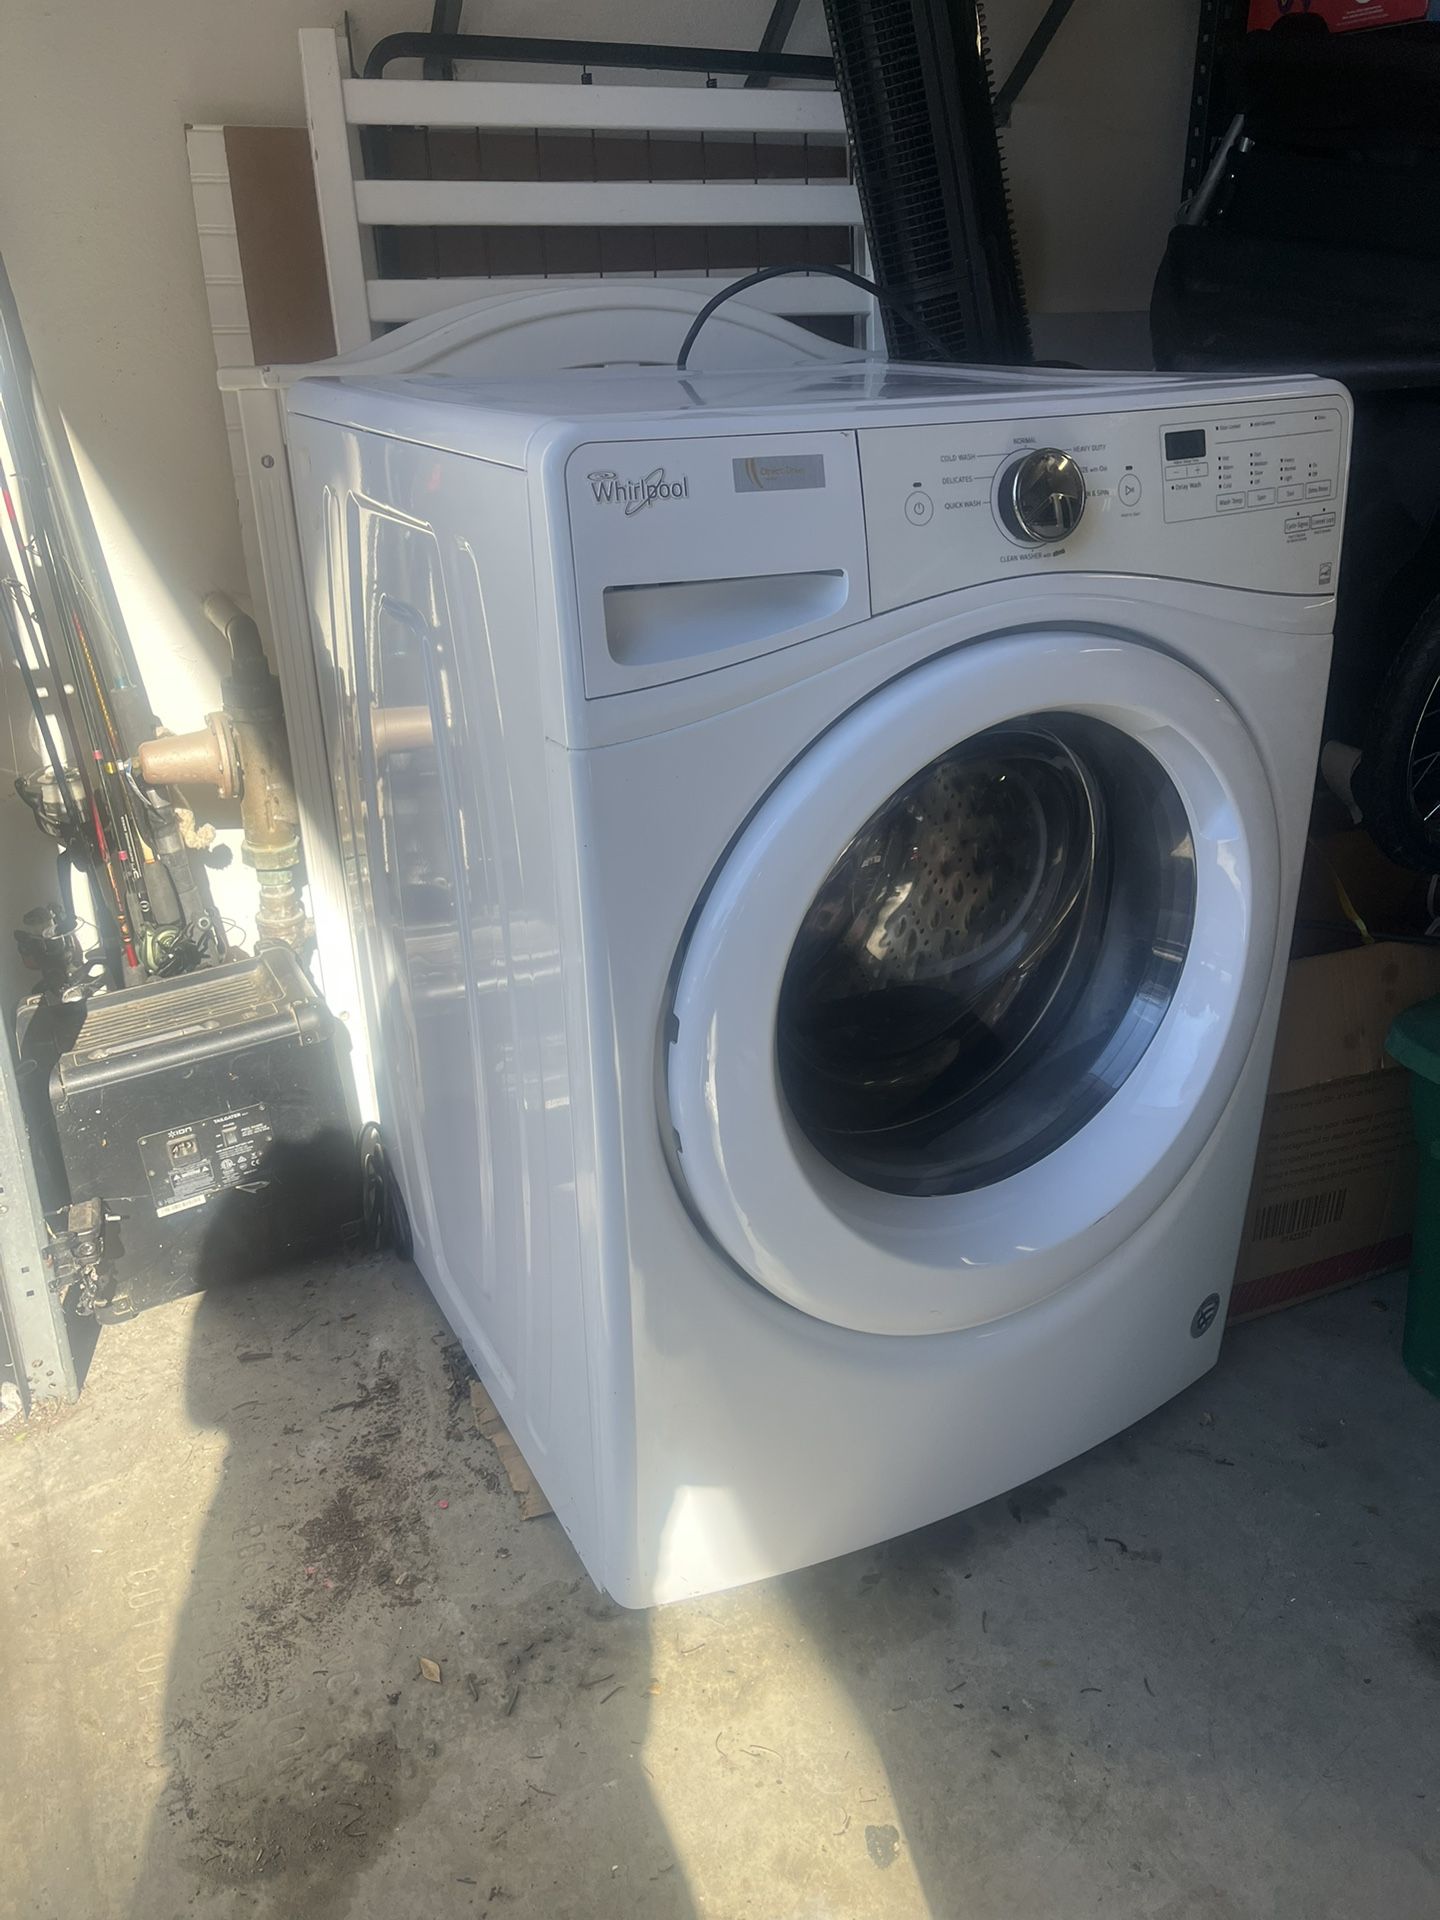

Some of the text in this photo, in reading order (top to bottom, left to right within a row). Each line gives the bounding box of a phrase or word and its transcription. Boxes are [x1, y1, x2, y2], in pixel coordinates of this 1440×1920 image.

[1013, 437, 1037, 445] NORMAL
[1073, 444, 1106, 453] HEAVY DUTY
[940, 453, 976, 463] COLD WASH
[942, 476, 973, 485] DELICATES
[590, 475, 690, 508] Whirlpool
[945, 500, 982, 510] QUICK WASH
[1000, 554, 1019, 563] CLEAN
[1020, 552, 1042, 561] WASHER
